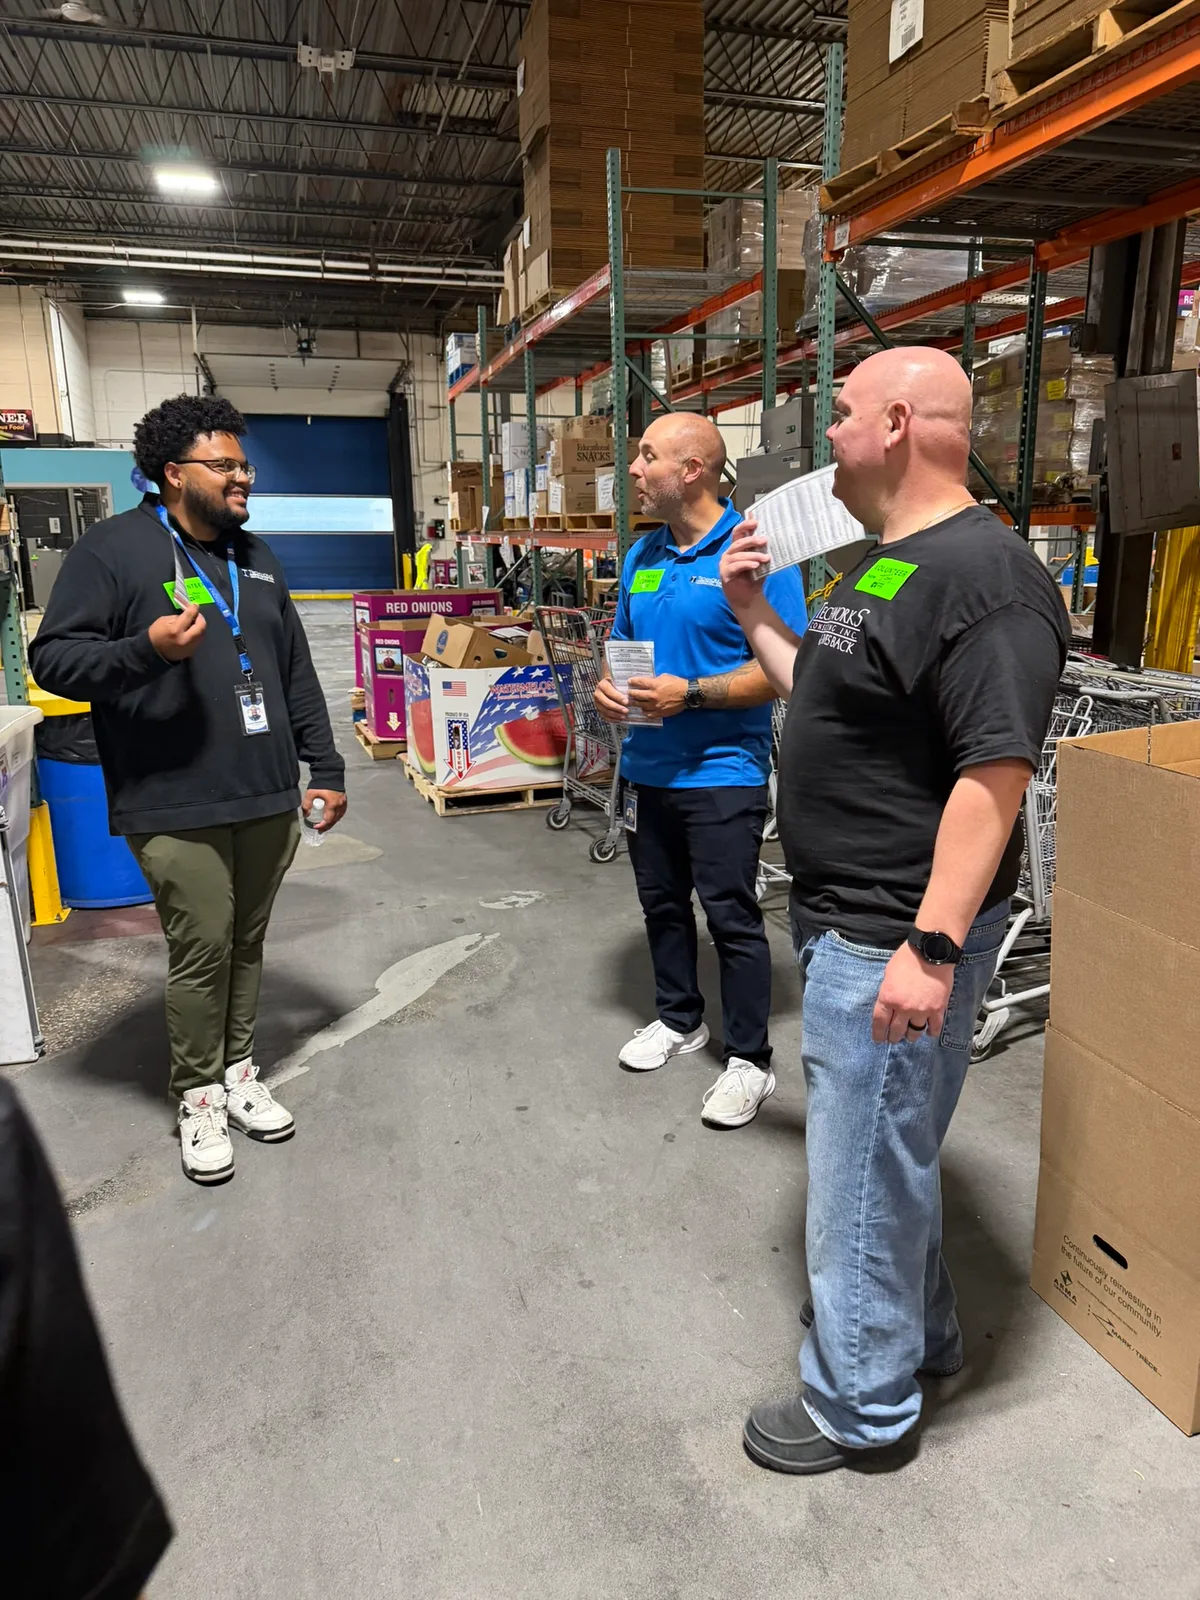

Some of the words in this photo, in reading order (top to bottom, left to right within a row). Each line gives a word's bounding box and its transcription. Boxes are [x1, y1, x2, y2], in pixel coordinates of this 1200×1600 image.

[577, 443, 610, 451] Educational
[577, 452, 611, 462] SNACKS
[386, 602, 408, 613] RED
[411, 602, 453, 613] ONIONS
[829, 636, 855, 655] BACK
[1063, 1235, 1108, 1279] Continuously
[1110, 1276, 1152, 1317] reinvesting
[1154, 1311, 1162, 1324] in
[1053, 1278, 1078, 1303] ARMA
[1061, 1245, 1073, 1260] the
[1073, 1255, 1094, 1278] future
[1095, 1275, 1102, 1287] of
[1103, 1283, 1117, 1298] our
[1117, 1296, 1162, 1339] community.
